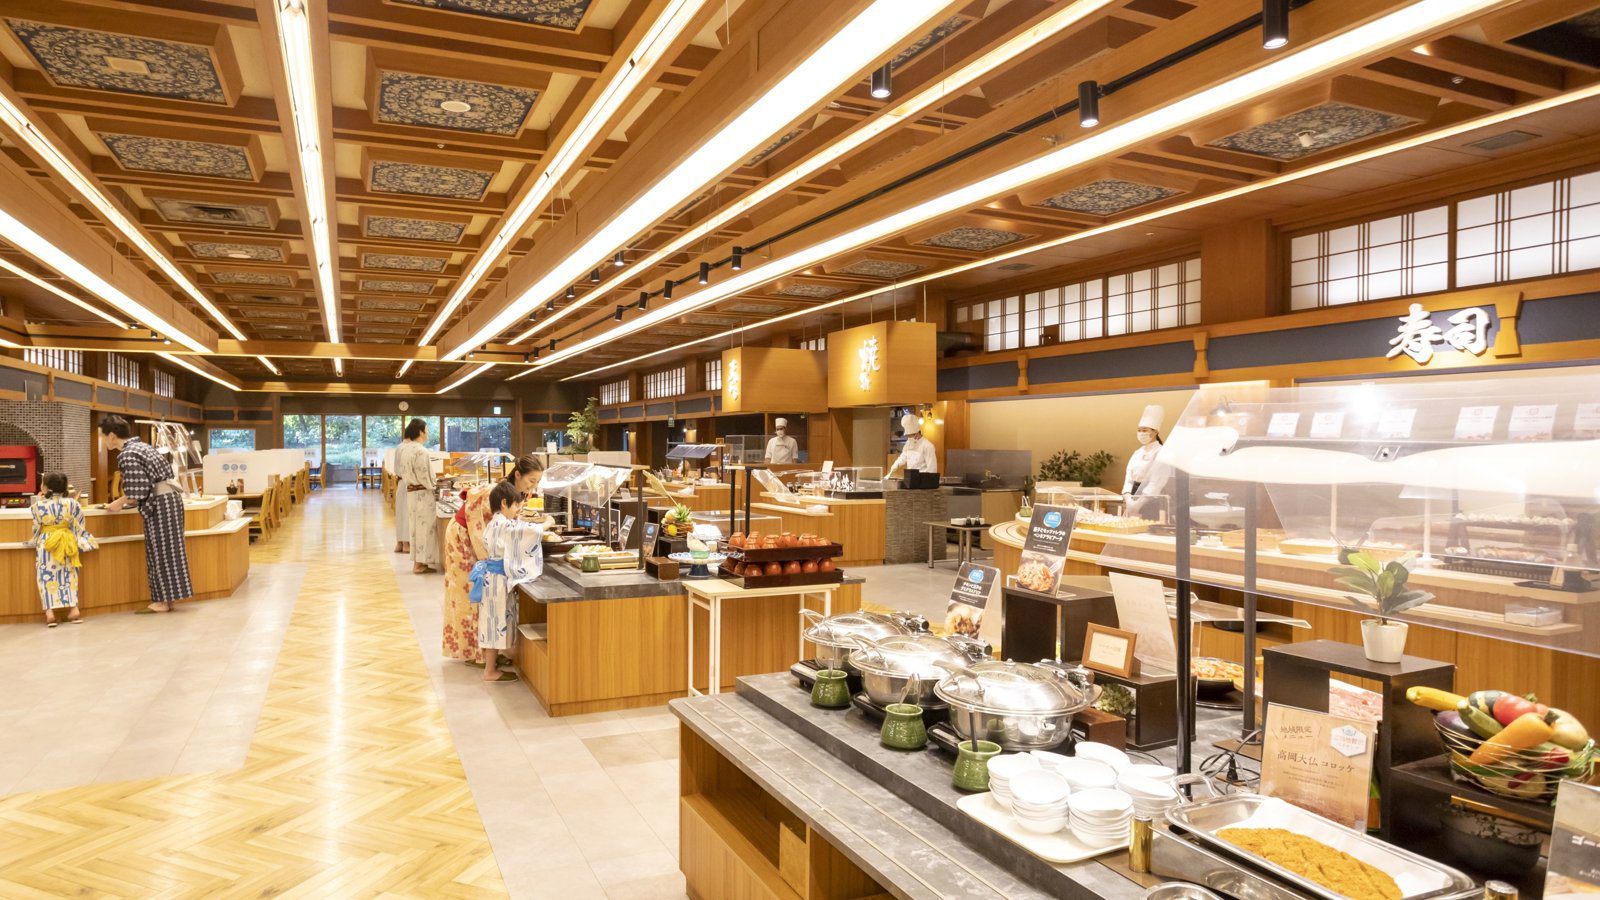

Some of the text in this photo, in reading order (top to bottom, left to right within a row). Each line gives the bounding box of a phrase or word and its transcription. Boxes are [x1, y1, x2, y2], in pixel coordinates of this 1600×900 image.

[1386, 303, 1492, 365] 寿司
[1280, 725, 1312, 734] 地域限定
[1277, 749, 1355, 773] 高岡大仏コロッケ
